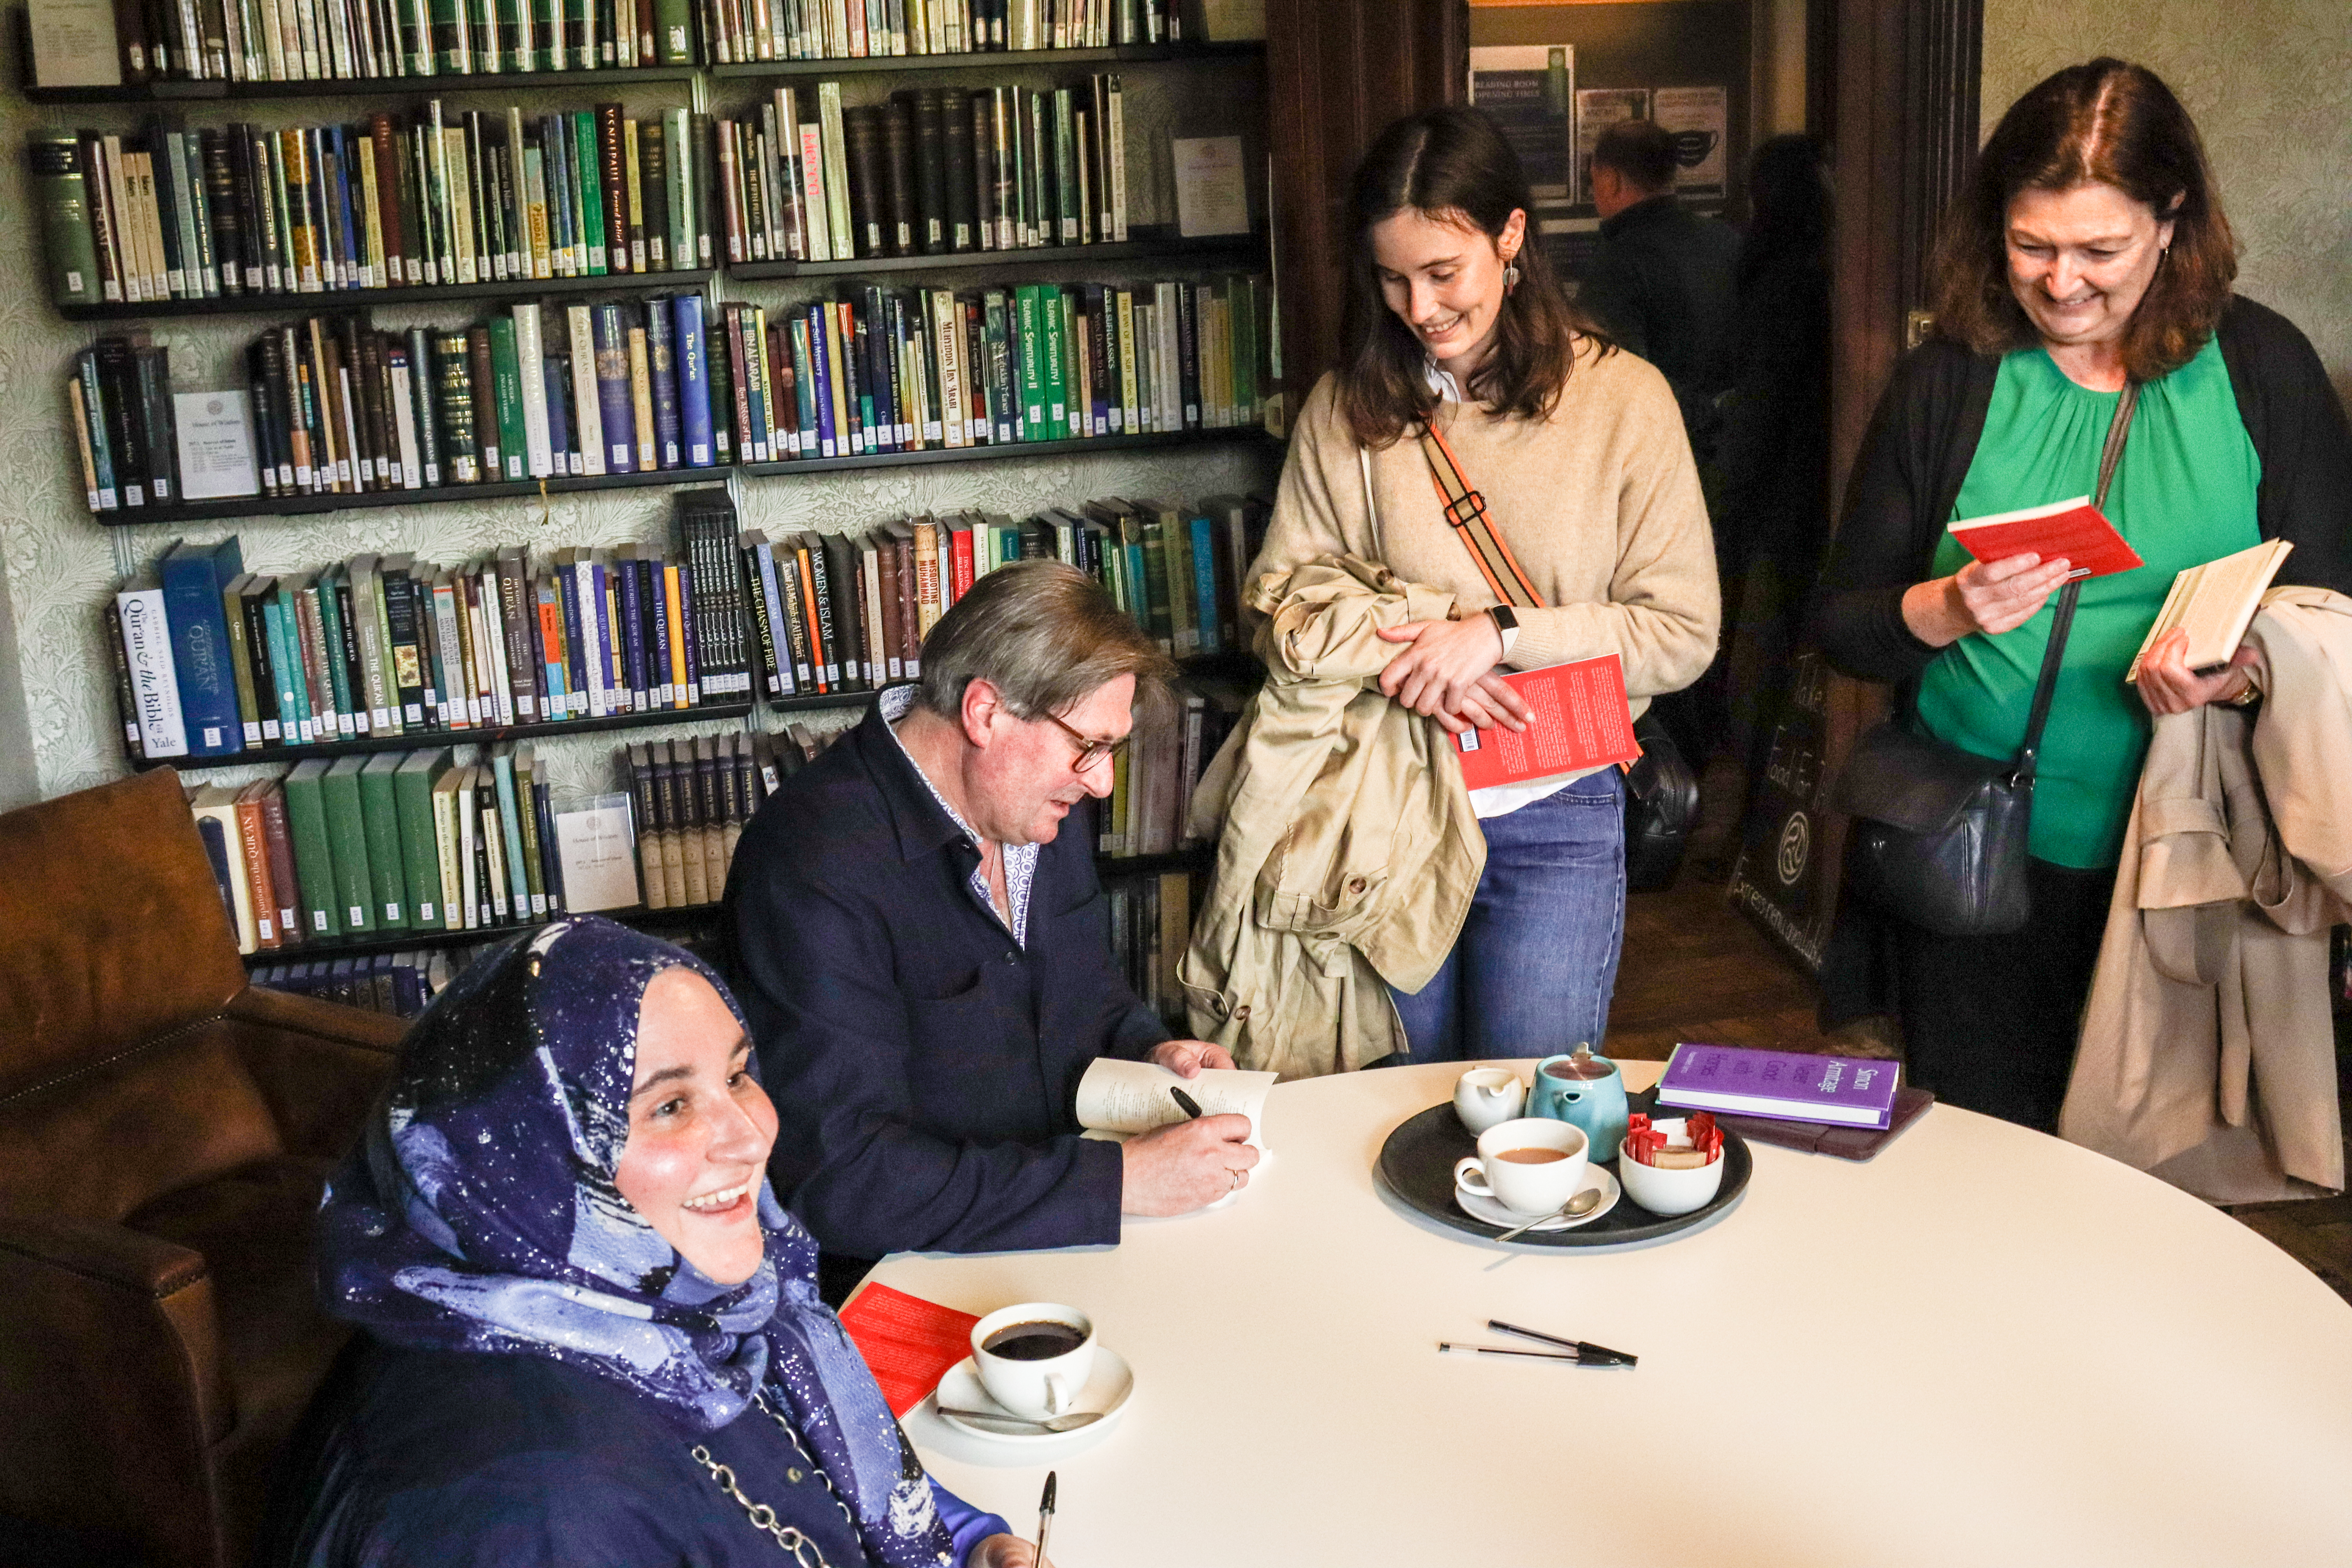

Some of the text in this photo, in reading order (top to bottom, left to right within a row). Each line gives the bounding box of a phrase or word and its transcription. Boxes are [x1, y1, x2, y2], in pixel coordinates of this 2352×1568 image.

[803, 133, 820, 196] Mecca
[612, 190, 623, 242] Beyond Belief
[1023, 299, 1032, 329] ISLAMIC
[1047, 299, 1056, 329] ISLAMIC
[745, 329, 756, 346] IBN
[812, 328, 820, 345] Sufi
[942, 321, 954, 366] MUHYIDDIN
[1123, 331, 1130, 341] OF
[686, 332, 697, 381] The Qur'an
[813, 346, 823, 376] Mystery
[1025, 332, 1034, 380] SPIRITUALITY
[1048, 332, 1058, 379] SPIRITUALITY
[1097, 359, 1103, 368] TO
[947, 369, 956, 382] IBN
[1000, 387, 1009, 415] Maneri
[89, 412, 100, 446] Experience
[420, 377, 429, 413] READING
[426, 431, 434, 460] QUR'AN
[626, 566, 635, 607] DISCOVERING
[680, 569, 689, 610] Understanding
[813, 551, 833, 640] WOMEN & ISLAM
[919, 560, 930, 604] MUHAMMAD
[929, 559, 938, 604] MISQUOTING
[377, 593, 386, 626] Interpreting
[564, 574, 575, 625] UNDERSTANDING
[766, 582, 777, 619] OF ISLAM
[124, 599, 146, 650] Qur'an
[599, 613, 607, 642] QUR'AN
[656, 619, 666, 650] QUR'AN
[751, 576, 776, 670] THE CHASM OF FIRE
[189, 625, 211, 690] QUR'AN
[320, 646, 328, 657] OF
[444, 617, 454, 665] INTELLECTUALS
[136, 652, 152, 666] &
[151, 609, 174, 717] GABRIEL SAID REYNOLDS
[322, 661, 330, 677] THE
[139, 670, 156, 690] the
[370, 674, 383, 705] QUR'AN
[152, 737, 176, 748] Yale
[439, 798, 447, 825] Readings
[244, 817, 261, 884] to the QUR'AN
[1817, 1060, 1848, 1093] Armitage
[1853, 1068, 1879, 1091] Simon
